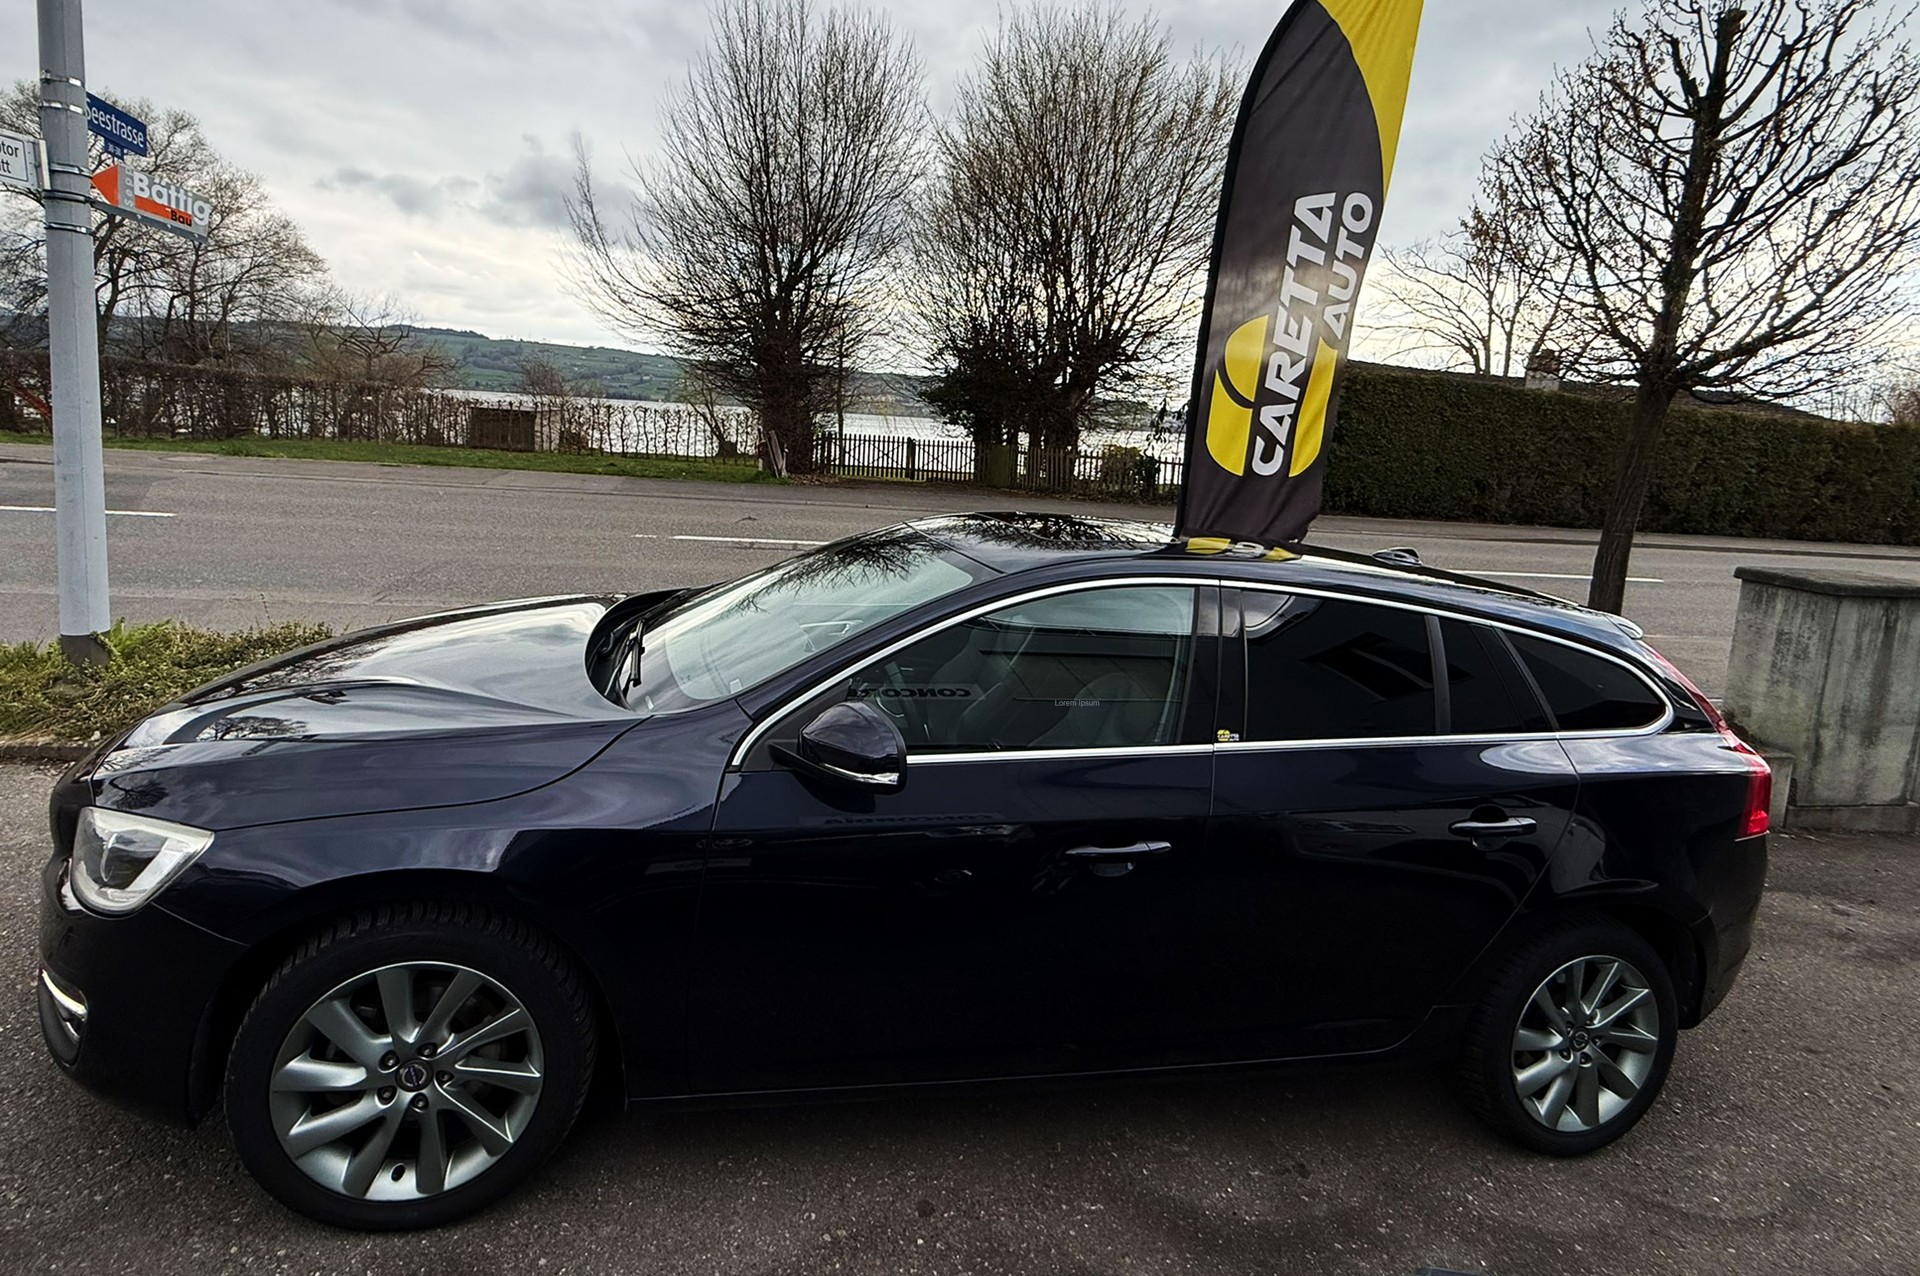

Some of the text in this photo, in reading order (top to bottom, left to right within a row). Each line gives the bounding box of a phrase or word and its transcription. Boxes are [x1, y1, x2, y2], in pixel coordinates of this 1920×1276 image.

[0, 141, 19, 158] tor
[0, 159, 12, 174] tt
[133, 171, 212, 226] Bättig
[170, 209, 192, 227] Bau
[1323, 192, 1373, 340] AUTO
[1252, 192, 1337, 476] CARETTA
